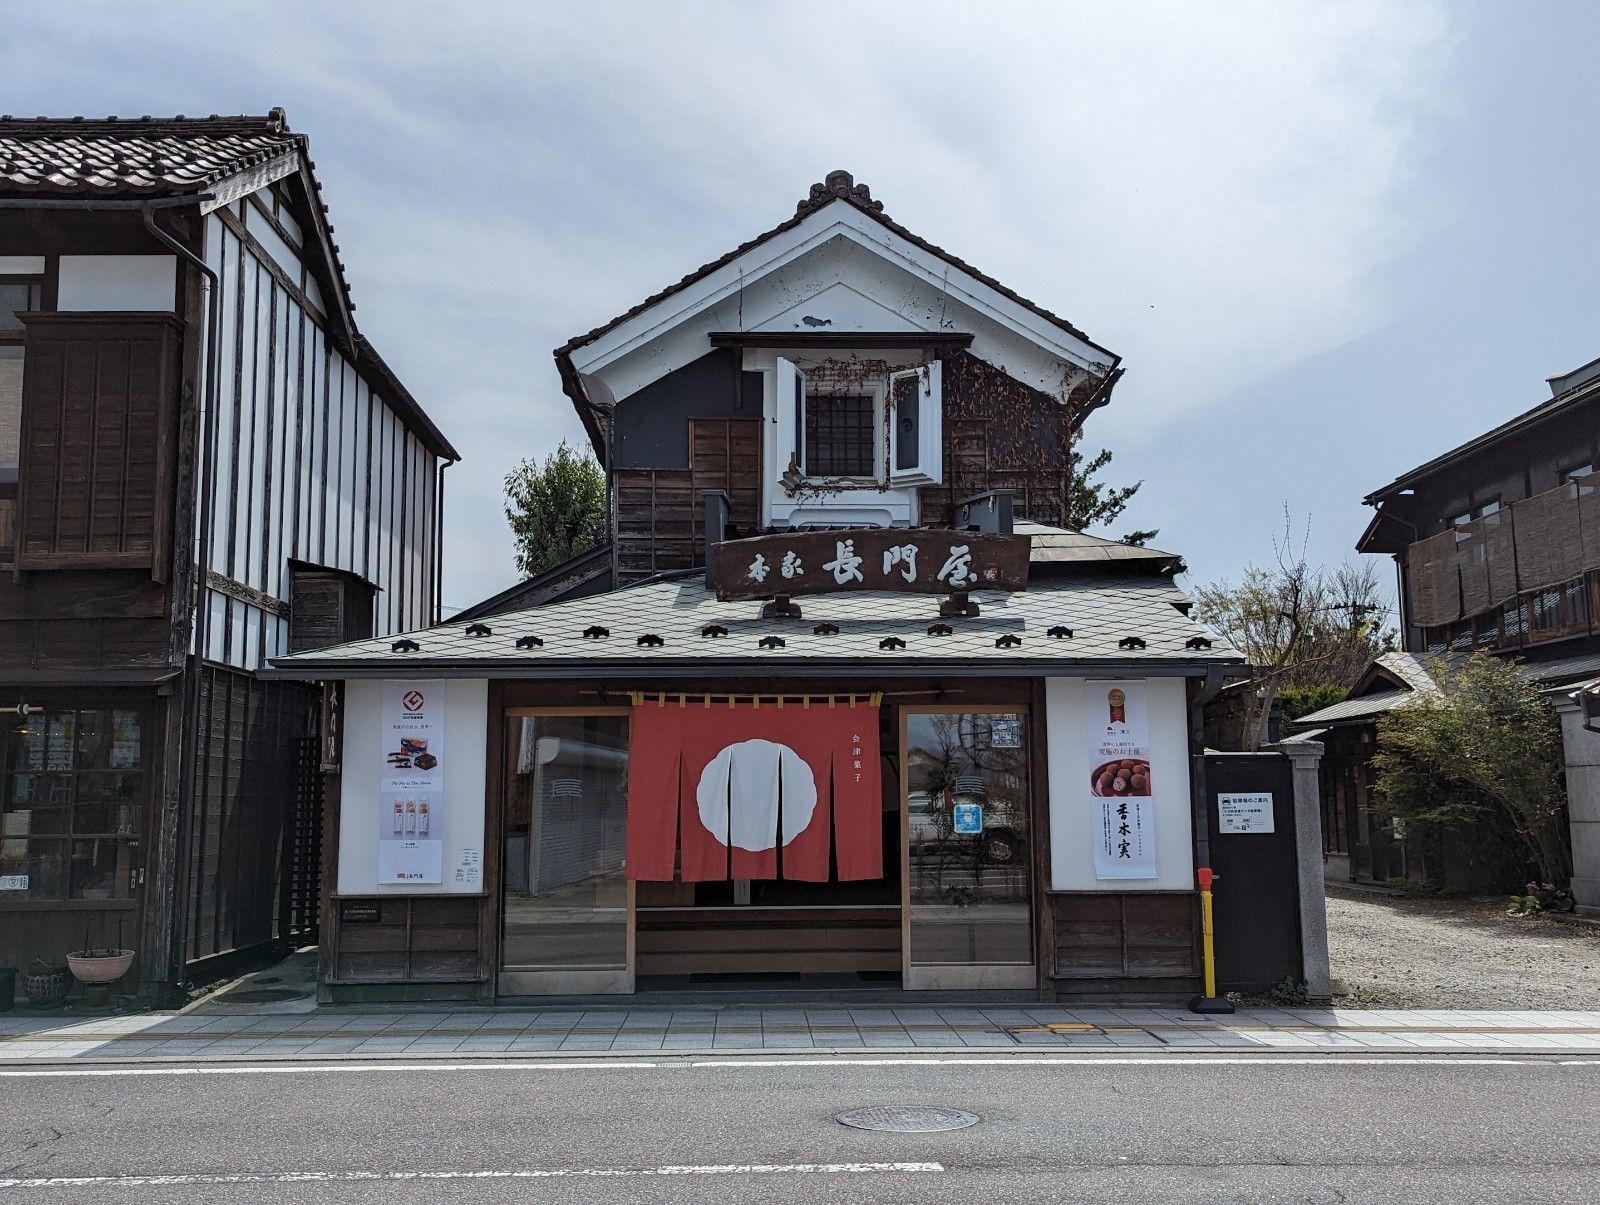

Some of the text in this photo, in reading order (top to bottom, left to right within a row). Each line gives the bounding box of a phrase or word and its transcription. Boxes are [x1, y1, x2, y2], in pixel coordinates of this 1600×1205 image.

[822, 538, 978, 587] 長門屋
[851, 734, 862, 782] 会津菓子
[1099, 748, 1141, 756] 究極のお土産
[1116, 803, 1132, 859] 香木実
